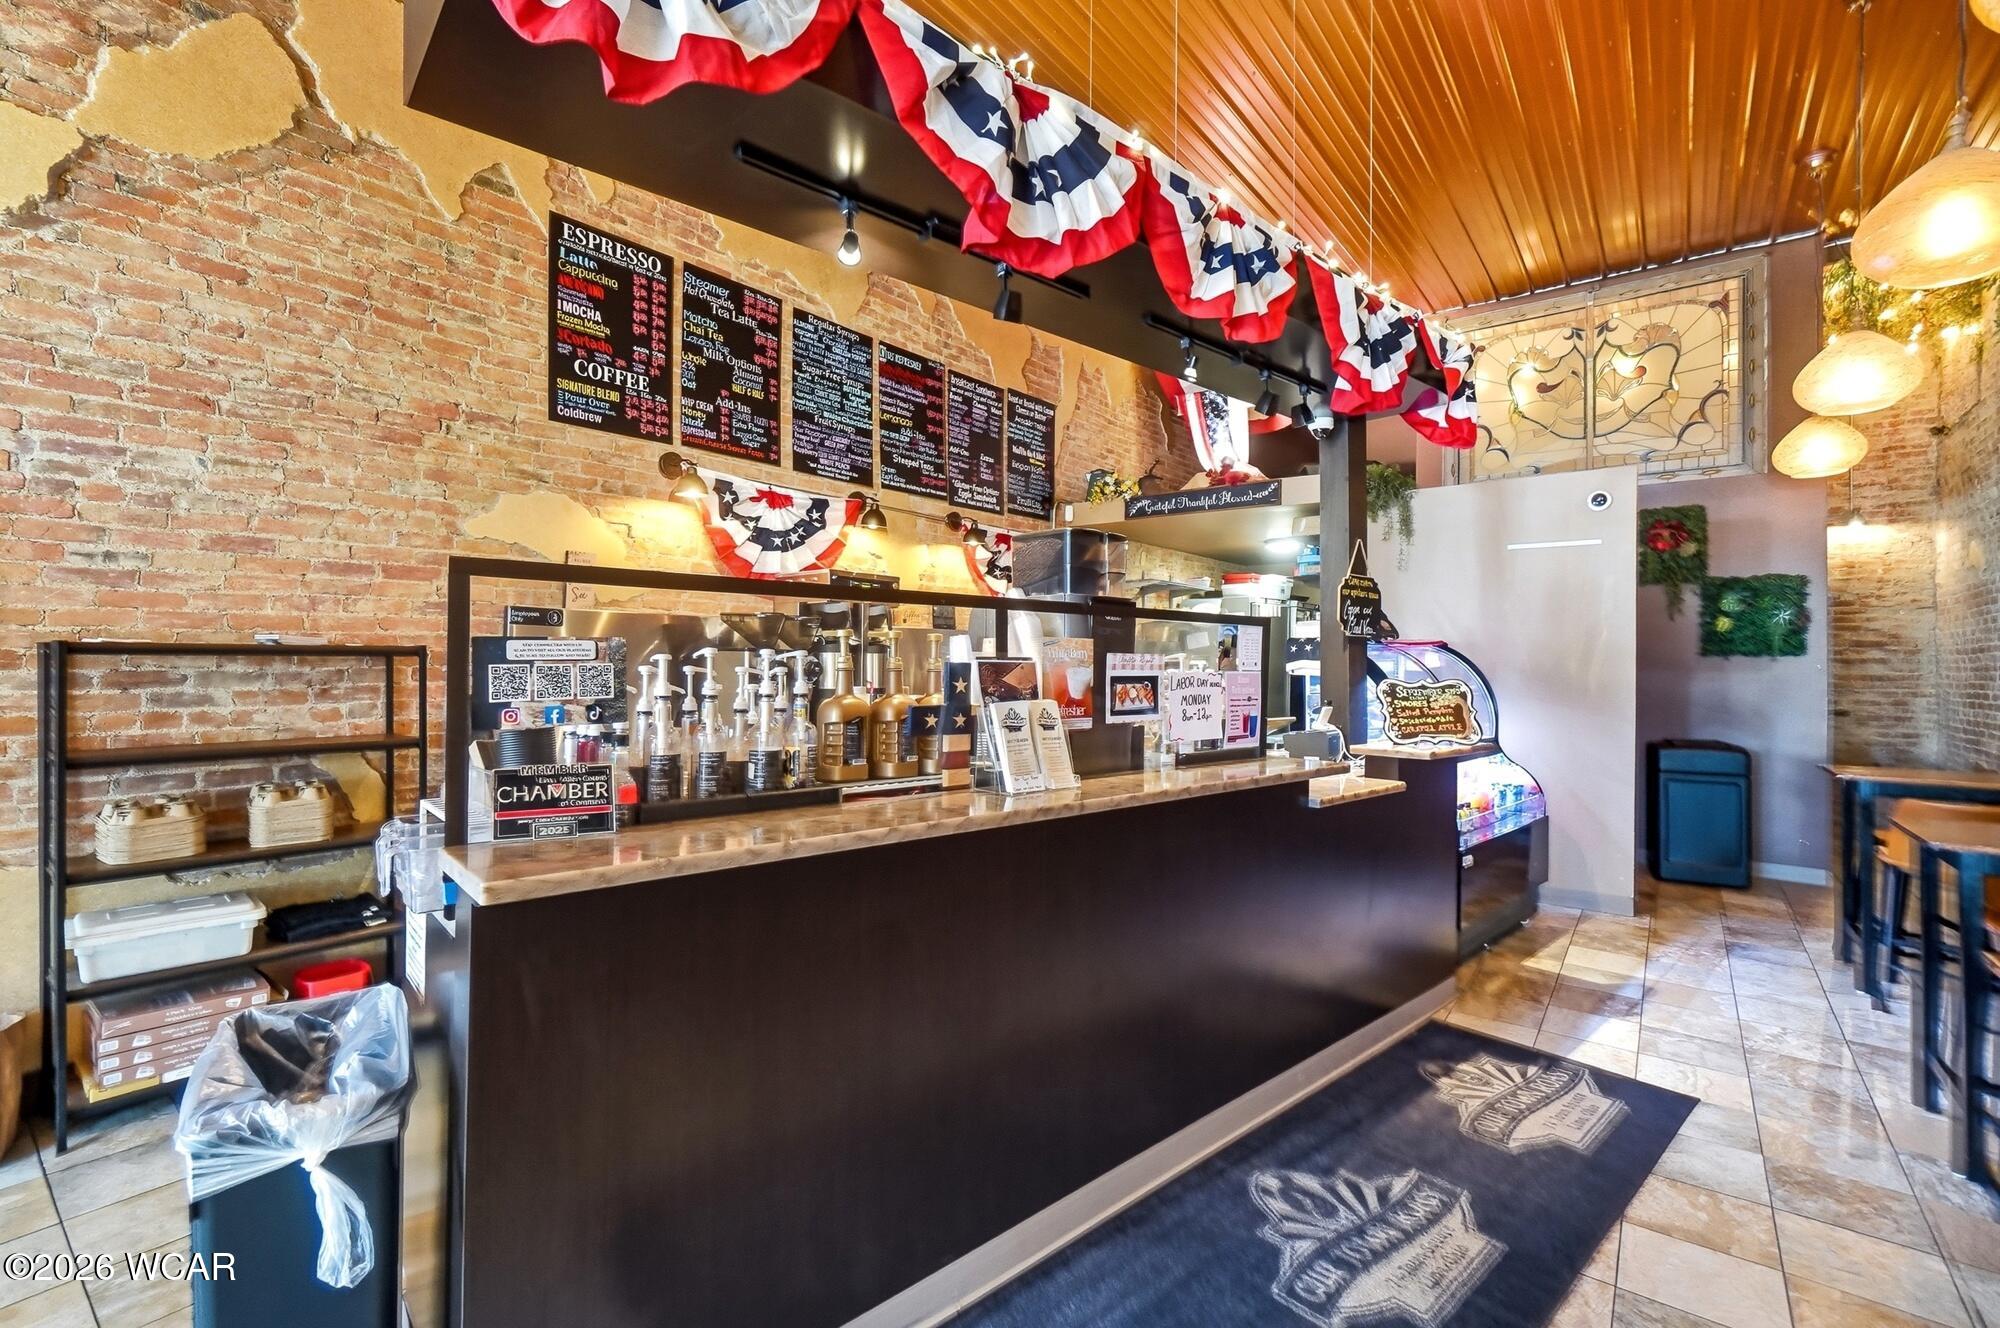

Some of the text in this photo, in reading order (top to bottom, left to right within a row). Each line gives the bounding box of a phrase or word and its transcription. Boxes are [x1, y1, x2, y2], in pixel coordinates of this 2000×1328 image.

[561, 220, 661, 274] ESPRESSO
[559, 245, 597, 271] Latte
[558, 258, 618, 290] Cappuccino
[684, 270, 729, 298] Steamer
[684, 282, 698, 297] Hot
[699, 288, 734, 310] Chocolate
[556, 310, 582, 326] Frozen
[584, 319, 610, 335] Mocha
[684, 309, 717, 330] Matcha
[710, 302, 729, 319] Tea
[732, 310, 757, 329] Latte
[684, 320, 723, 342] Chai Tea
[808, 314, 859, 343] Regular Syrups
[682, 350, 706, 366] Whole
[682, 360, 695, 371] 2%
[703, 346, 761, 375] Milk Options
[574, 358, 649, 392] COFFEE
[682, 378, 696, 389] Oat
[732, 365, 763, 383] Almond
[732, 375, 761, 390] Coconut
[802, 361, 841, 385] Sugar-Free
[842, 375, 864, 392] Syrups
[556, 377, 619, 402] SIGNATURE BLEND
[565, 392, 586, 404] Pour
[588, 397, 610, 409] Over
[696, 400, 713, 413] CREAM
[716, 395, 751, 414] Add-Ins
[557, 404, 602, 423] Coldbrew
[682, 405, 706, 421] Honey
[1145, 490, 1253, 514] Grateful Thankful Blessed
[512, 610, 540, 618] Employees
[1170, 676, 1209, 691] LABOR DAY
[1181, 694, 1211, 706] MONDAY
[1396, 707, 1454, 718] Salted Pumpkin
[1401, 725, 1436, 734] CARAMEL
[518, 763, 588, 776] MEMBER
[497, 782, 609, 804] CHAMBER
